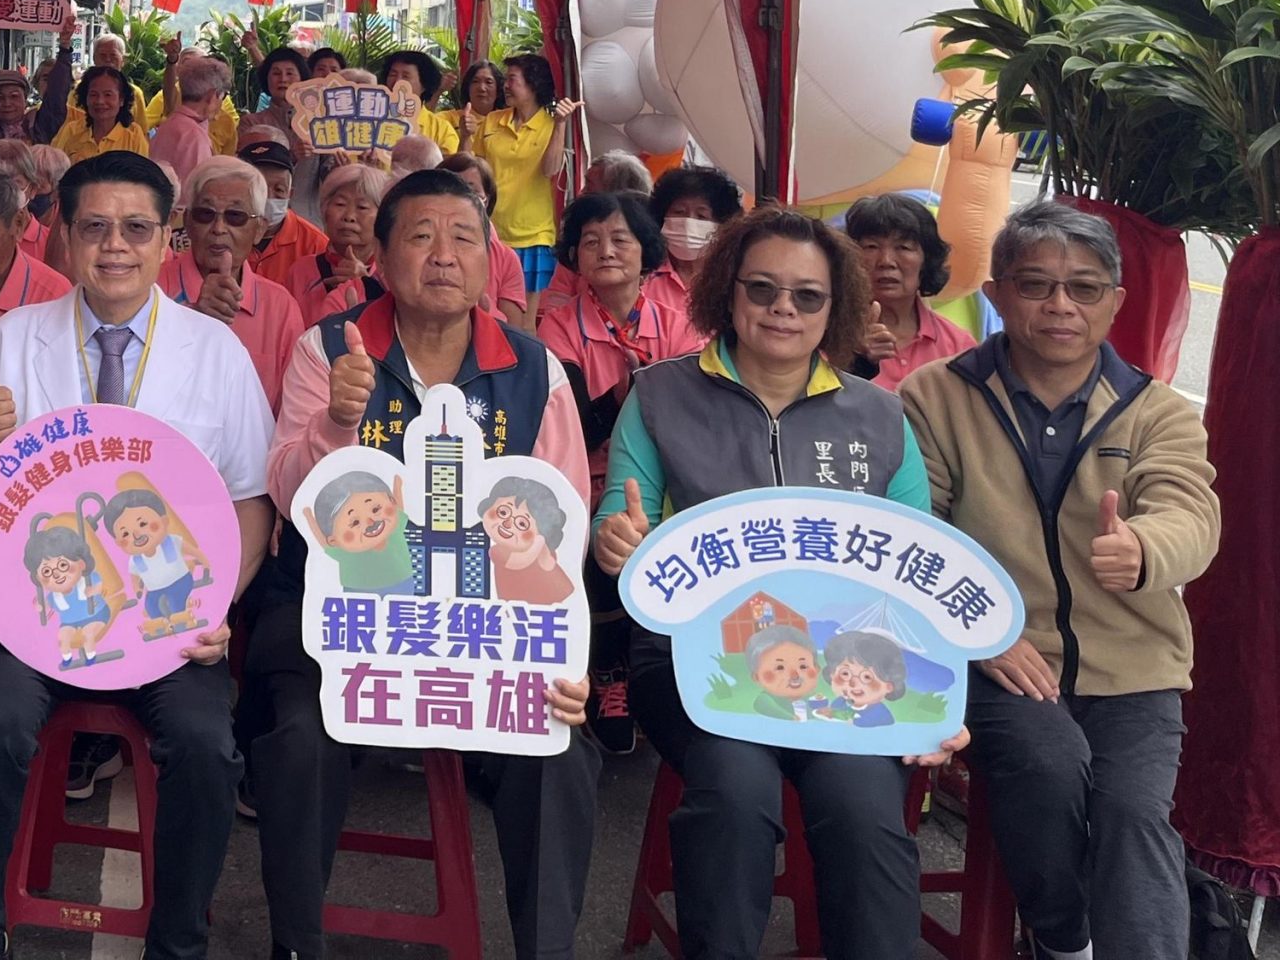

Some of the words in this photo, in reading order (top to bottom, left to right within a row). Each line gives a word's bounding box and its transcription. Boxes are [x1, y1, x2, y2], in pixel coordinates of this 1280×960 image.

[325, 88, 387, 118] 運動
[361, 418, 391, 449] 林
[388, 399, 403, 435] 助理
[493, 409, 508, 457] 高雄市
[814, 441, 840, 485] 里長
[644, 516, 997, 631] 均衡營養好健康
[321, 596, 569, 666] 銀髮樂活
[340, 661, 551, 736] 在高雄
